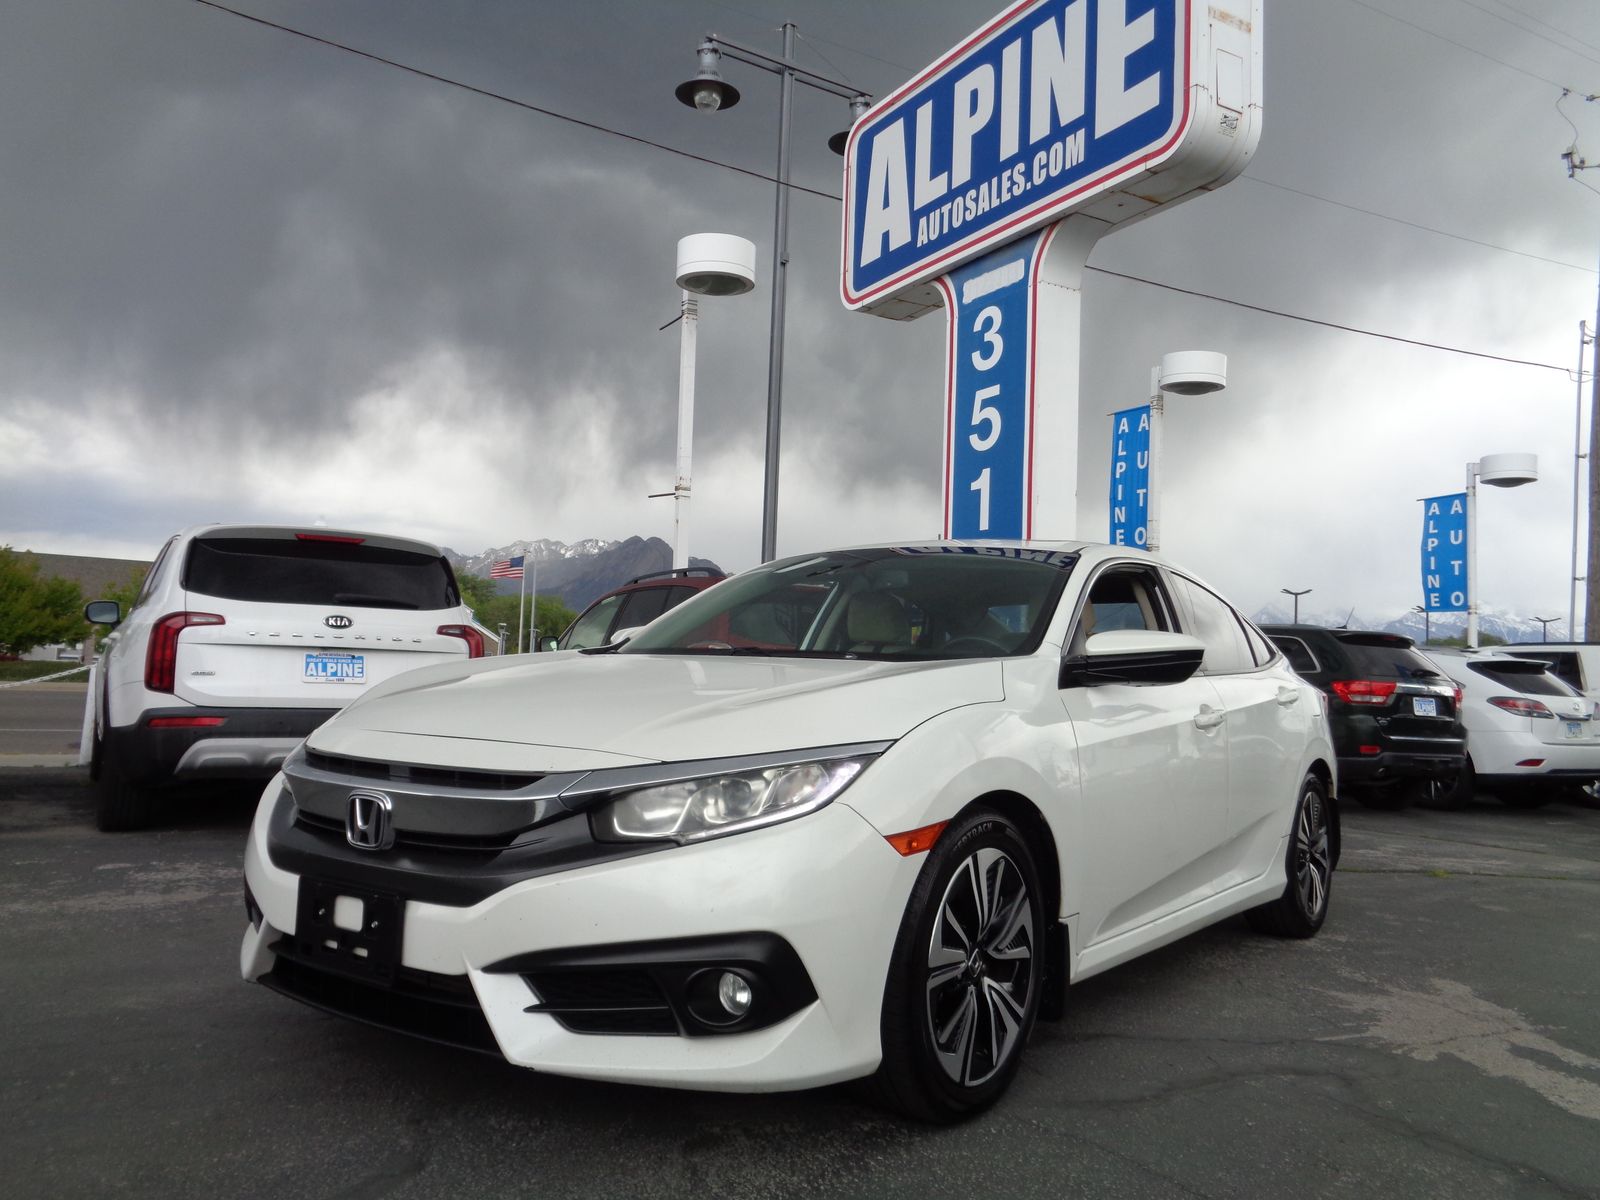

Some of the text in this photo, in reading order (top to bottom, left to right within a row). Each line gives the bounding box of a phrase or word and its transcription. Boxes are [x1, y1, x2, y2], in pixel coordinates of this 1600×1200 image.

[860, 0, 1160, 268] ALPINE
[917, 128, 1085, 248] AUTOSALES.COM
[969, 305, 1004, 531] 351
[1114, 417, 1129, 546] ALPINE
[1134, 413, 1150, 545] AUTO
[1427, 502, 1441, 607] ALPINE
[1450, 499, 1465, 607] AUTO
[307, 662, 363, 677] ALPINE
[328, 617, 348, 625] KIA
